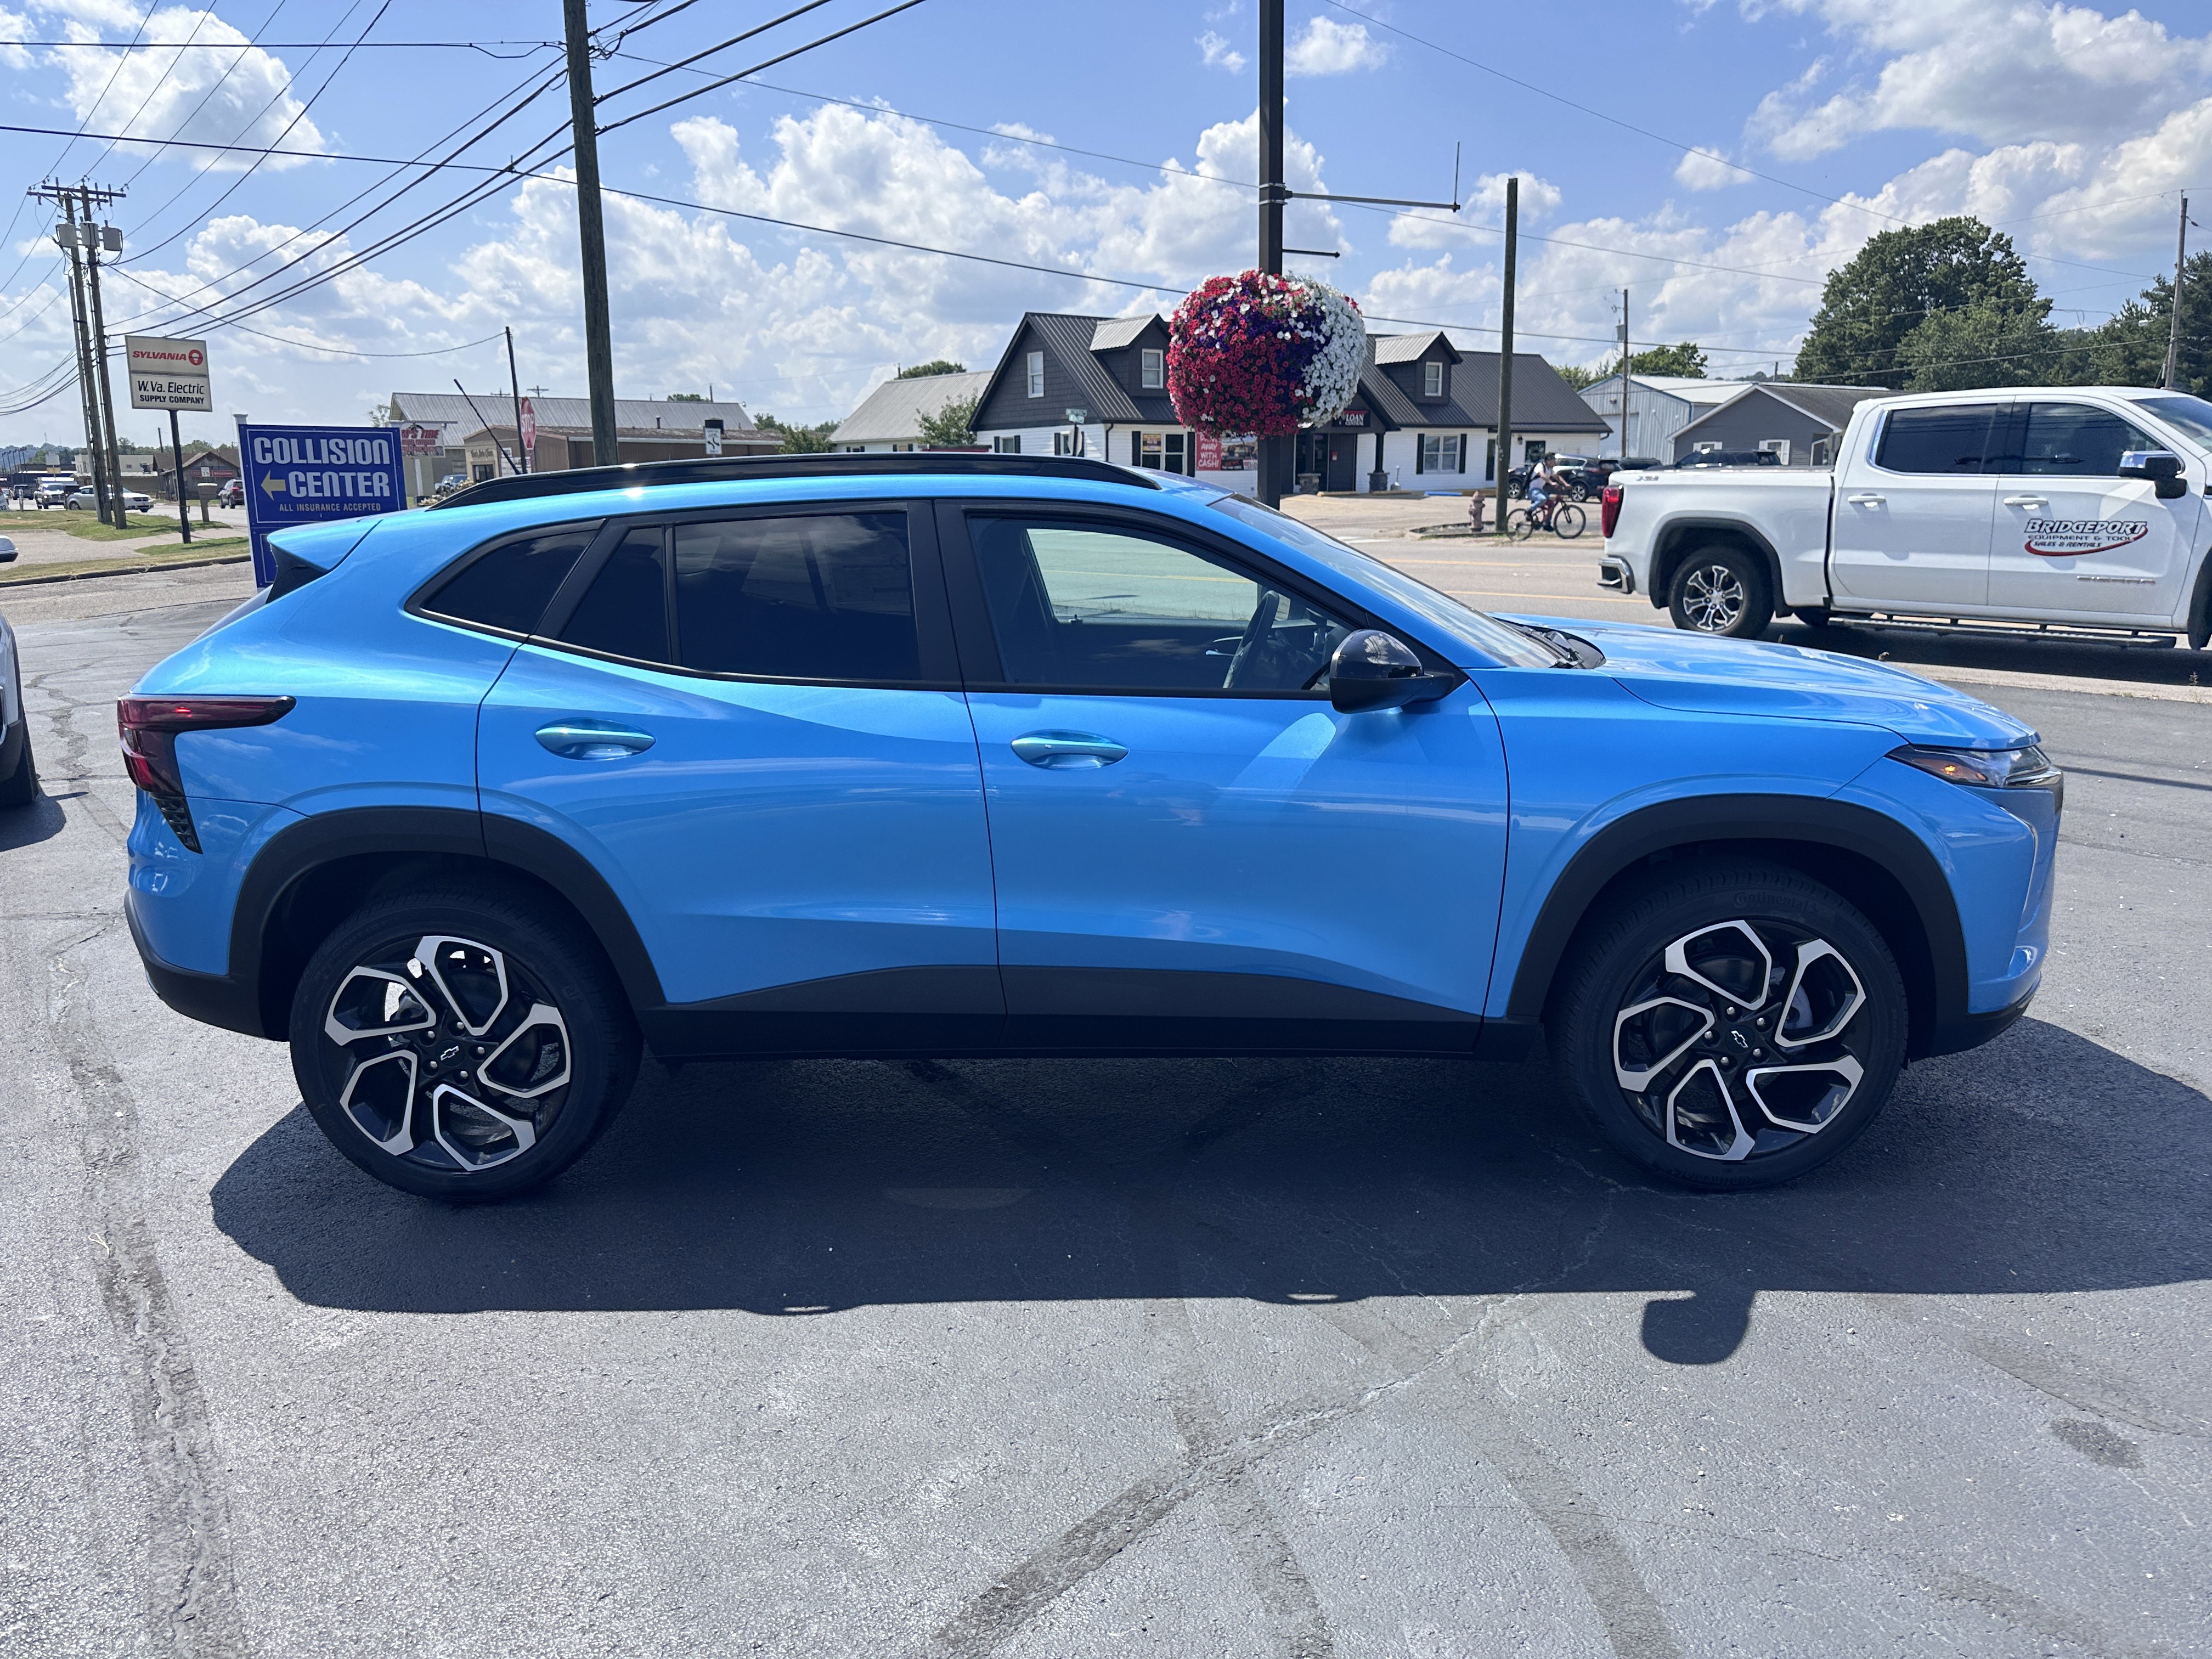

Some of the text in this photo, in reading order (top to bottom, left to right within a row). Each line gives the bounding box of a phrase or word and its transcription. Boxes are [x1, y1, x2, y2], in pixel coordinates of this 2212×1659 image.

[132, 351, 187, 360] SYLVANIA
[168, 382, 205, 394] Electric
[139, 394, 205, 404] SUPPLY COMPANY
[521, 413, 534, 433] STOP
[253, 437, 391, 465] COLLISION
[1198, 459, 1220, 468] CASH!
[288, 471, 391, 498] CENTER
[279, 503, 381, 512] ALL INSURANCE ACCEPTED
[2024, 518, 2148, 535] BRIDGEPORT
[1733, 891, 1809, 911] Continental
